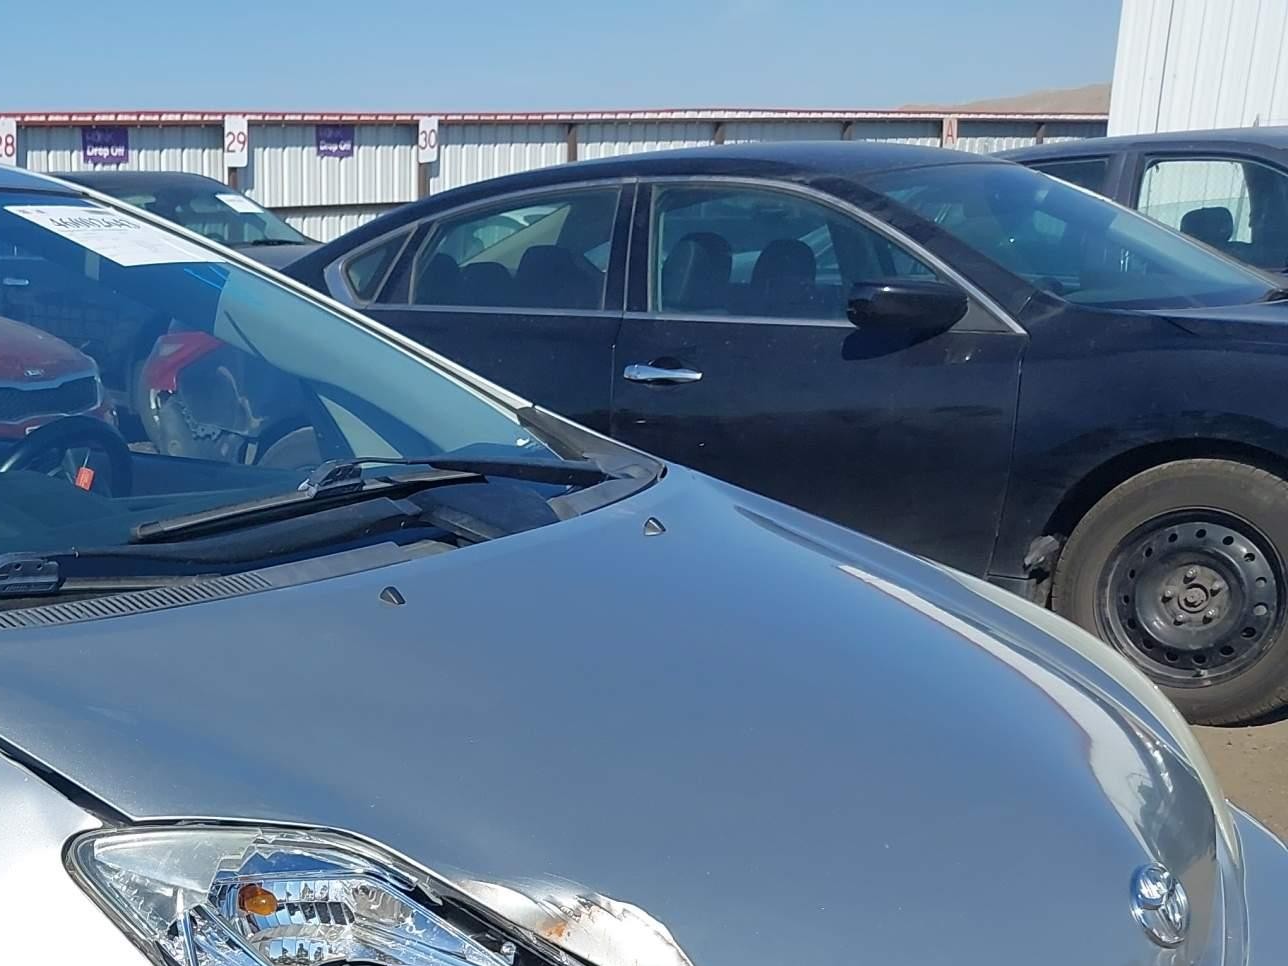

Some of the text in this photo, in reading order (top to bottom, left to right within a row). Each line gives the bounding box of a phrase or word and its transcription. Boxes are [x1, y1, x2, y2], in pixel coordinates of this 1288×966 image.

[225, 131, 247, 153] 29
[418, 128, 437, 150] 30
[86, 145, 109, 159] Drop
